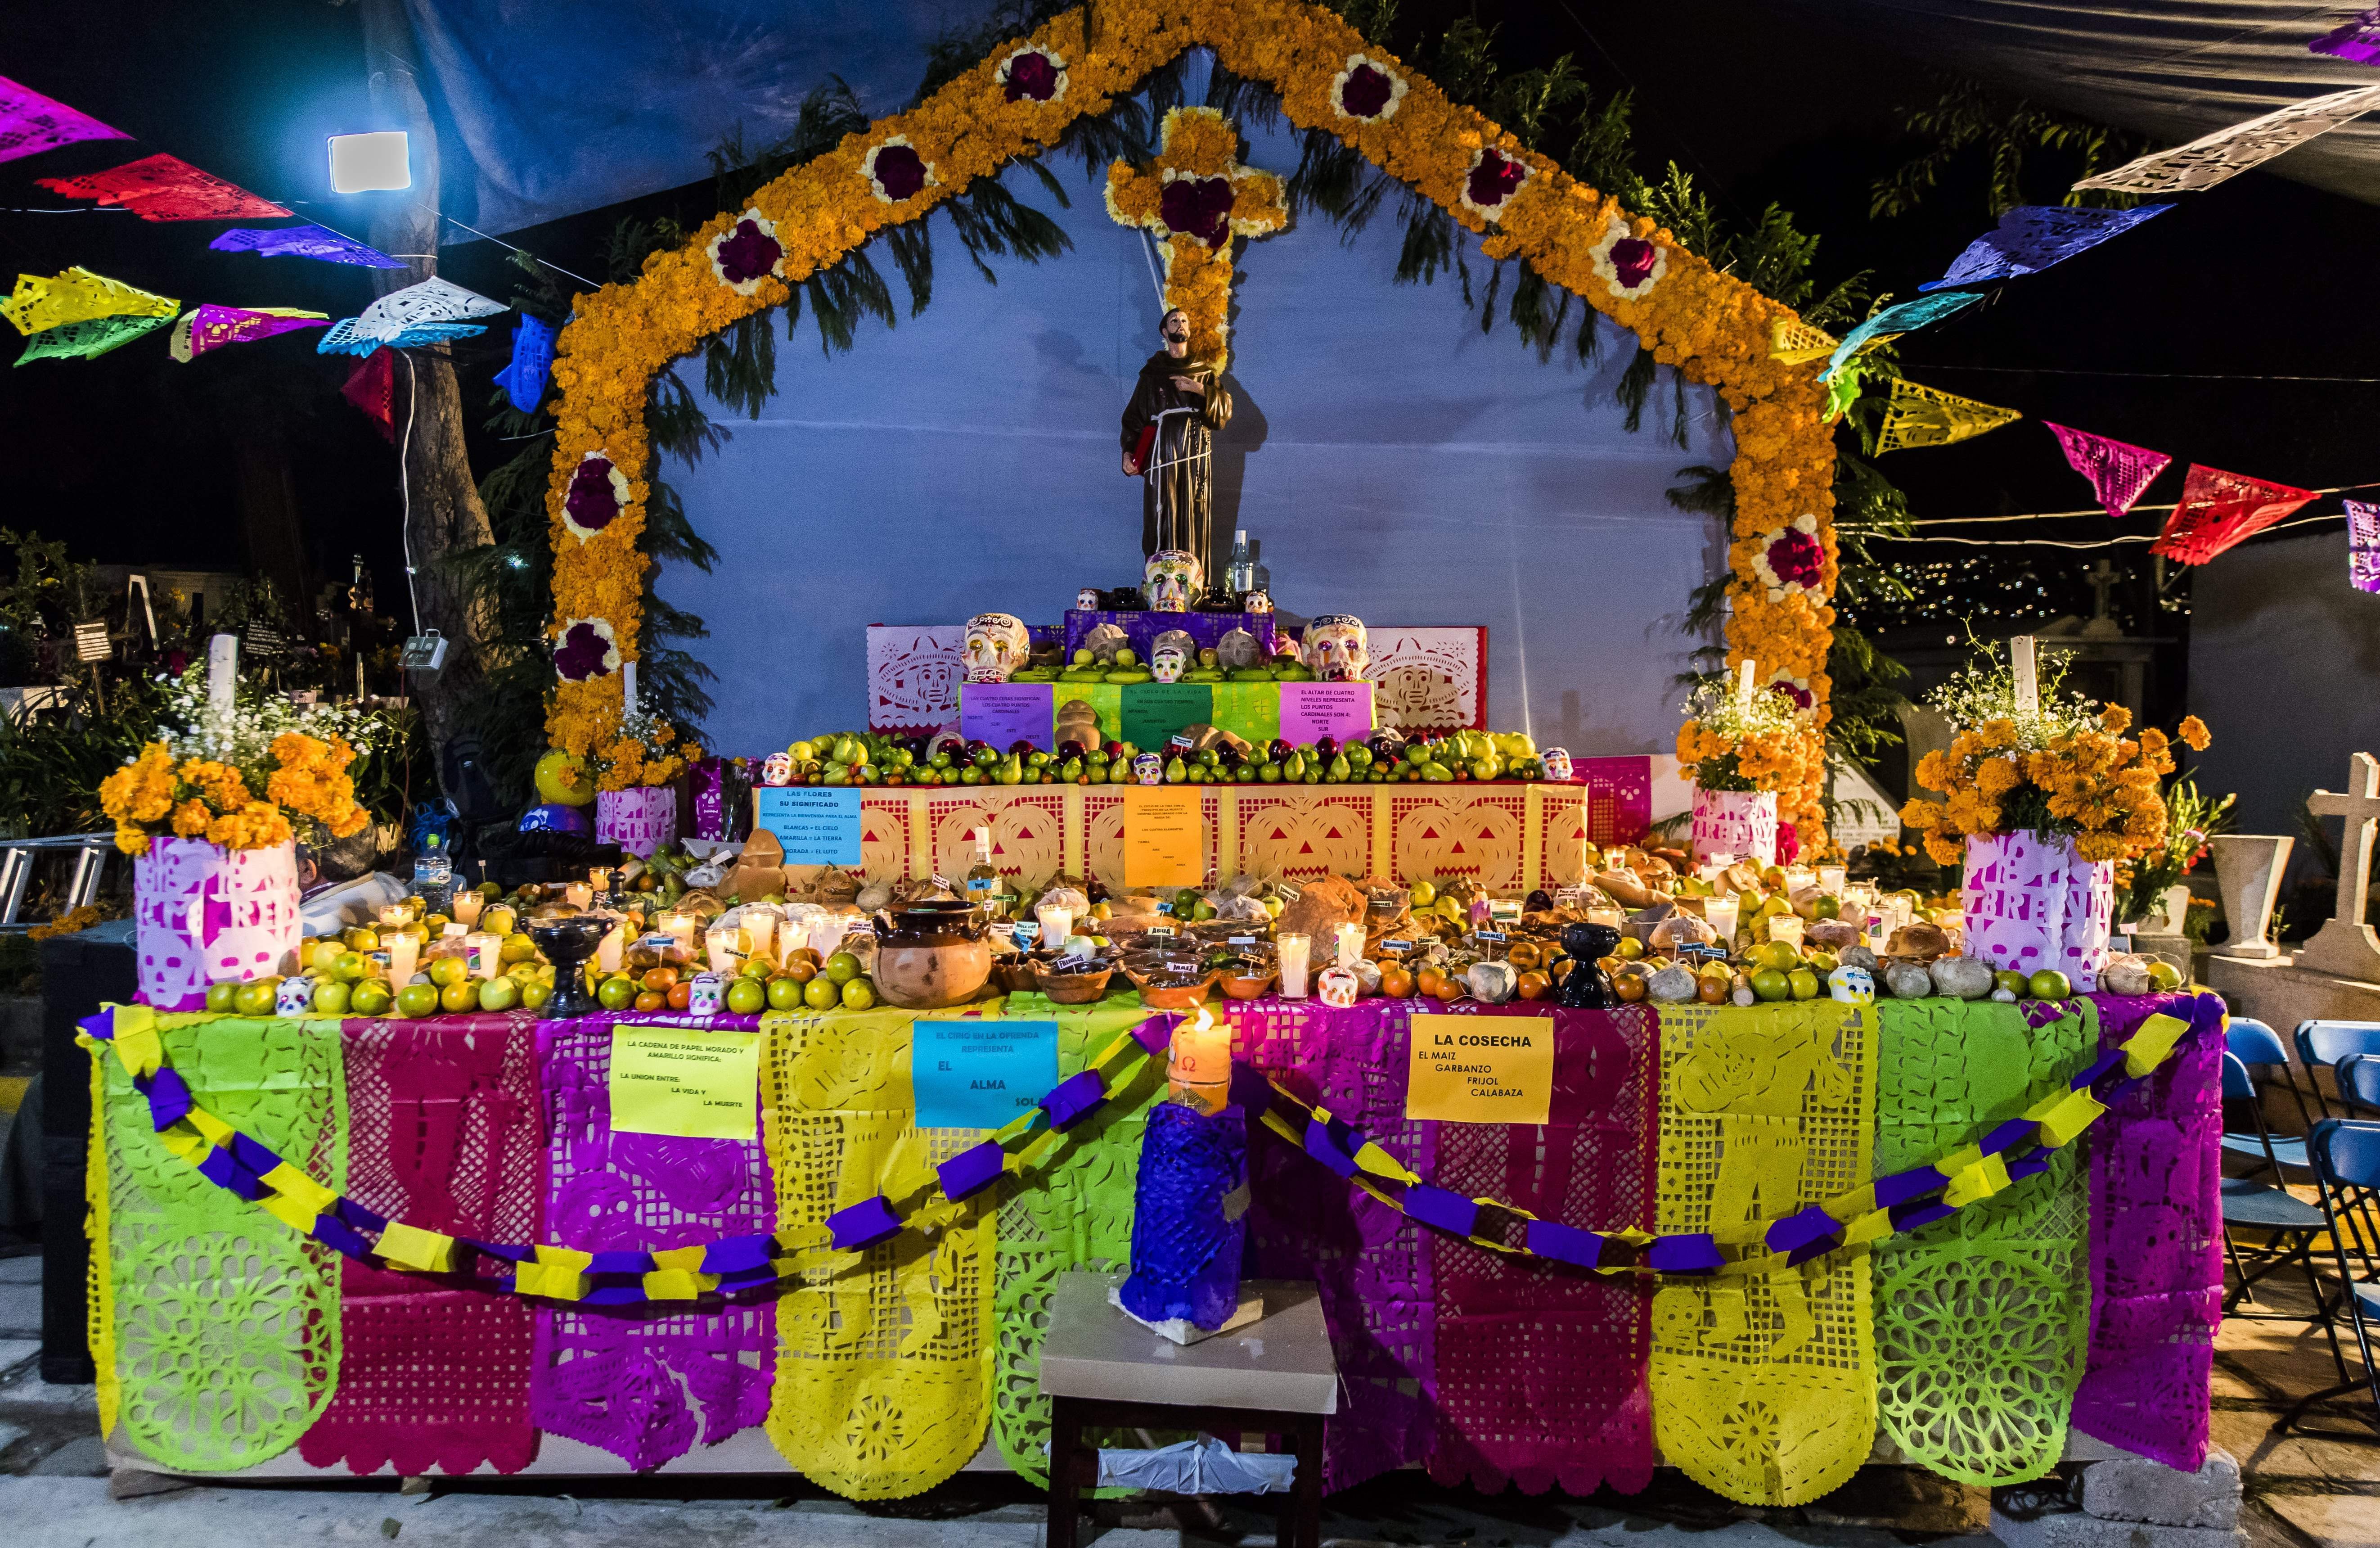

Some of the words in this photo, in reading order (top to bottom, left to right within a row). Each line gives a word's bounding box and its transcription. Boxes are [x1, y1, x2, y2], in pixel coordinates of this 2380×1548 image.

[1479, 932, 1503, 940] JICAMAS
[1059, 954, 1084, 968] FRIJOLES
[1242, 954, 1261, 963] SAL
[1172, 964, 1194, 973] MAIZ
[1435, 1034, 1454, 1045] LA
[1459, 1035, 1531, 1047] COSECHA
[648, 1052, 684, 1060] AMARILLO
[938, 1061, 952, 1071] EL
[1435, 1064, 1491, 1073] GARBANZO
[970, 1080, 1006, 1090] ALMA
[1467, 1077, 1498, 1085] FRIJOL
